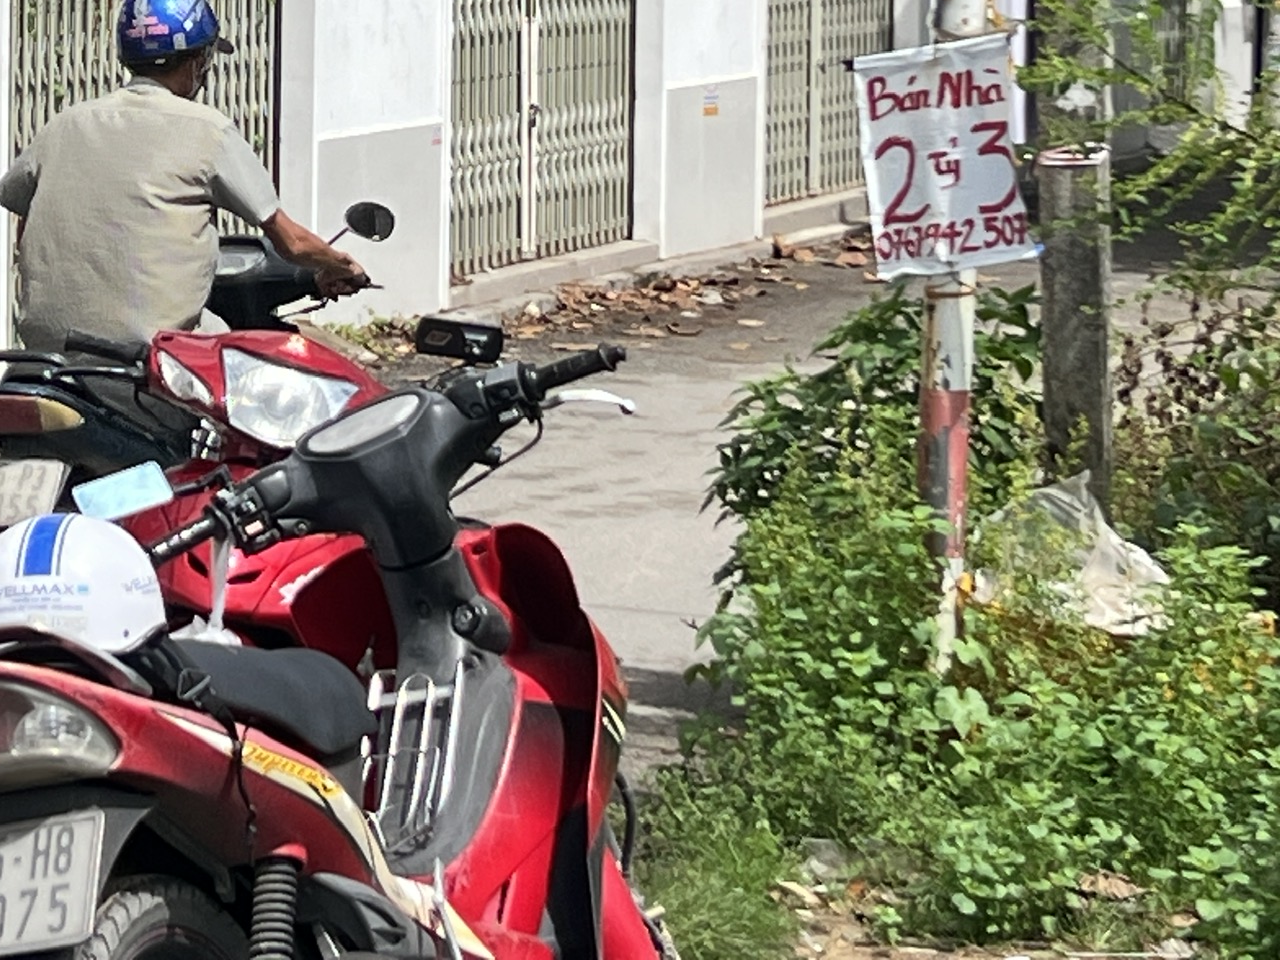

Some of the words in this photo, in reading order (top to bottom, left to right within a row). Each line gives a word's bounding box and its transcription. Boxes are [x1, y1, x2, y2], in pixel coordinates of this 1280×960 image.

[867, 75, 931, 121] Bán
[937, 68, 1006, 109] Nhà
[875, 136, 931, 227] 2
[970, 121, 1018, 214] 3
